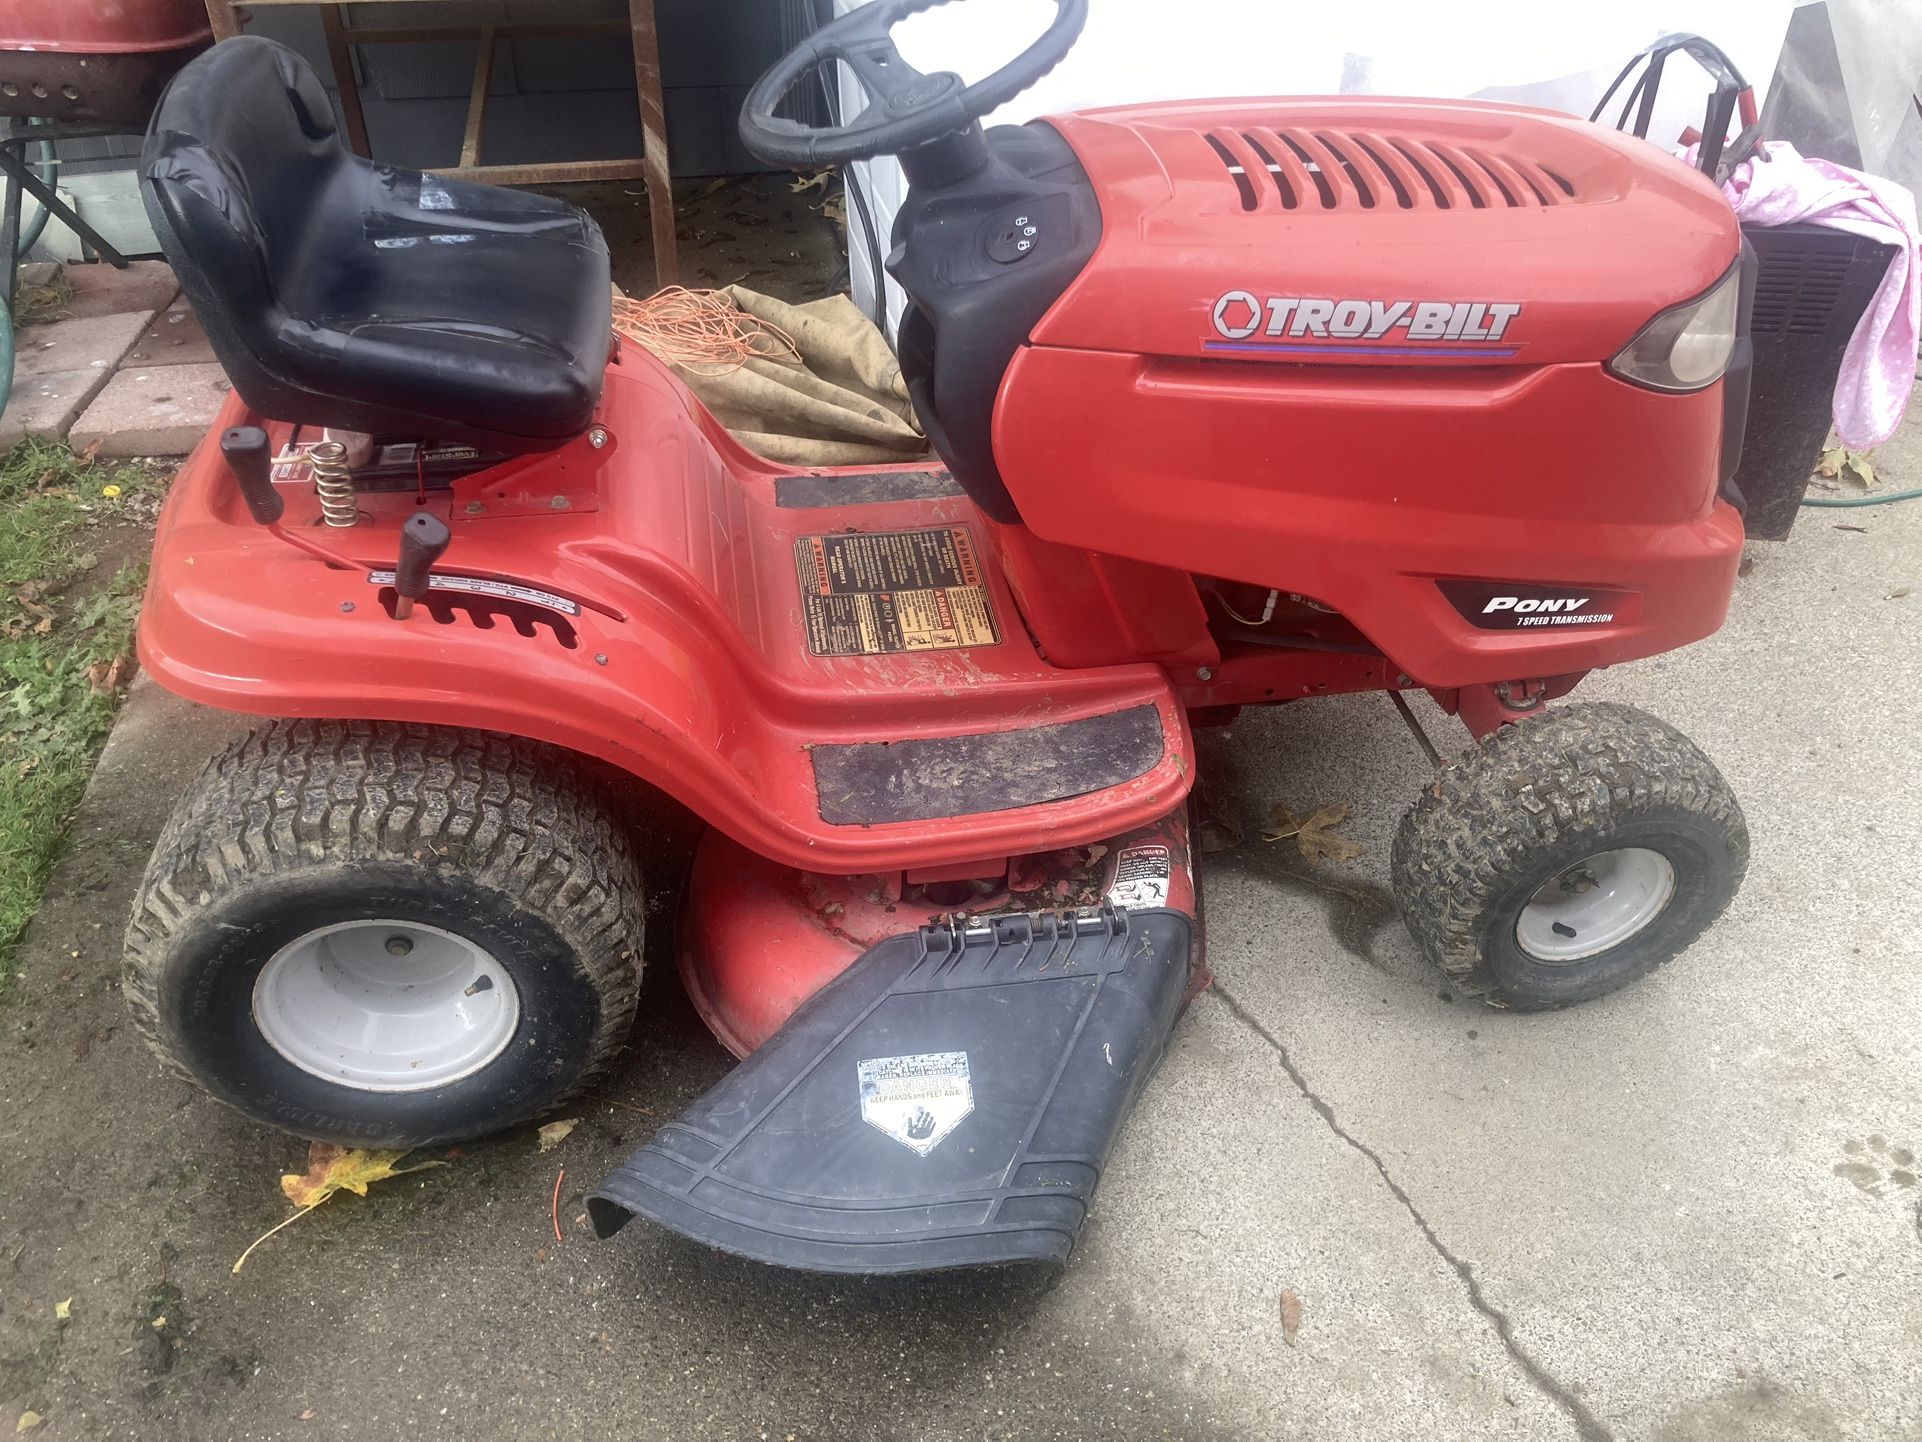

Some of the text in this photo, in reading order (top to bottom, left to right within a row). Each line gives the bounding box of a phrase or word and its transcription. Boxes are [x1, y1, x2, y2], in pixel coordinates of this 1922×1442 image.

[1264, 297, 1520, 342] TROY-BILT
[814, 550, 827, 587] WARNING
[956, 538, 977, 583] WARNING
[936, 596, 951, 627] DANGER
[1482, 597, 1590, 614] PONY
[1516, 614, 1614, 626] 7 SPEED TRANSMISSION
[879, 1077, 953, 1093] DANGER
[889, 1093, 912, 1103] HANDS
[926, 1091, 943, 1099] FEET
